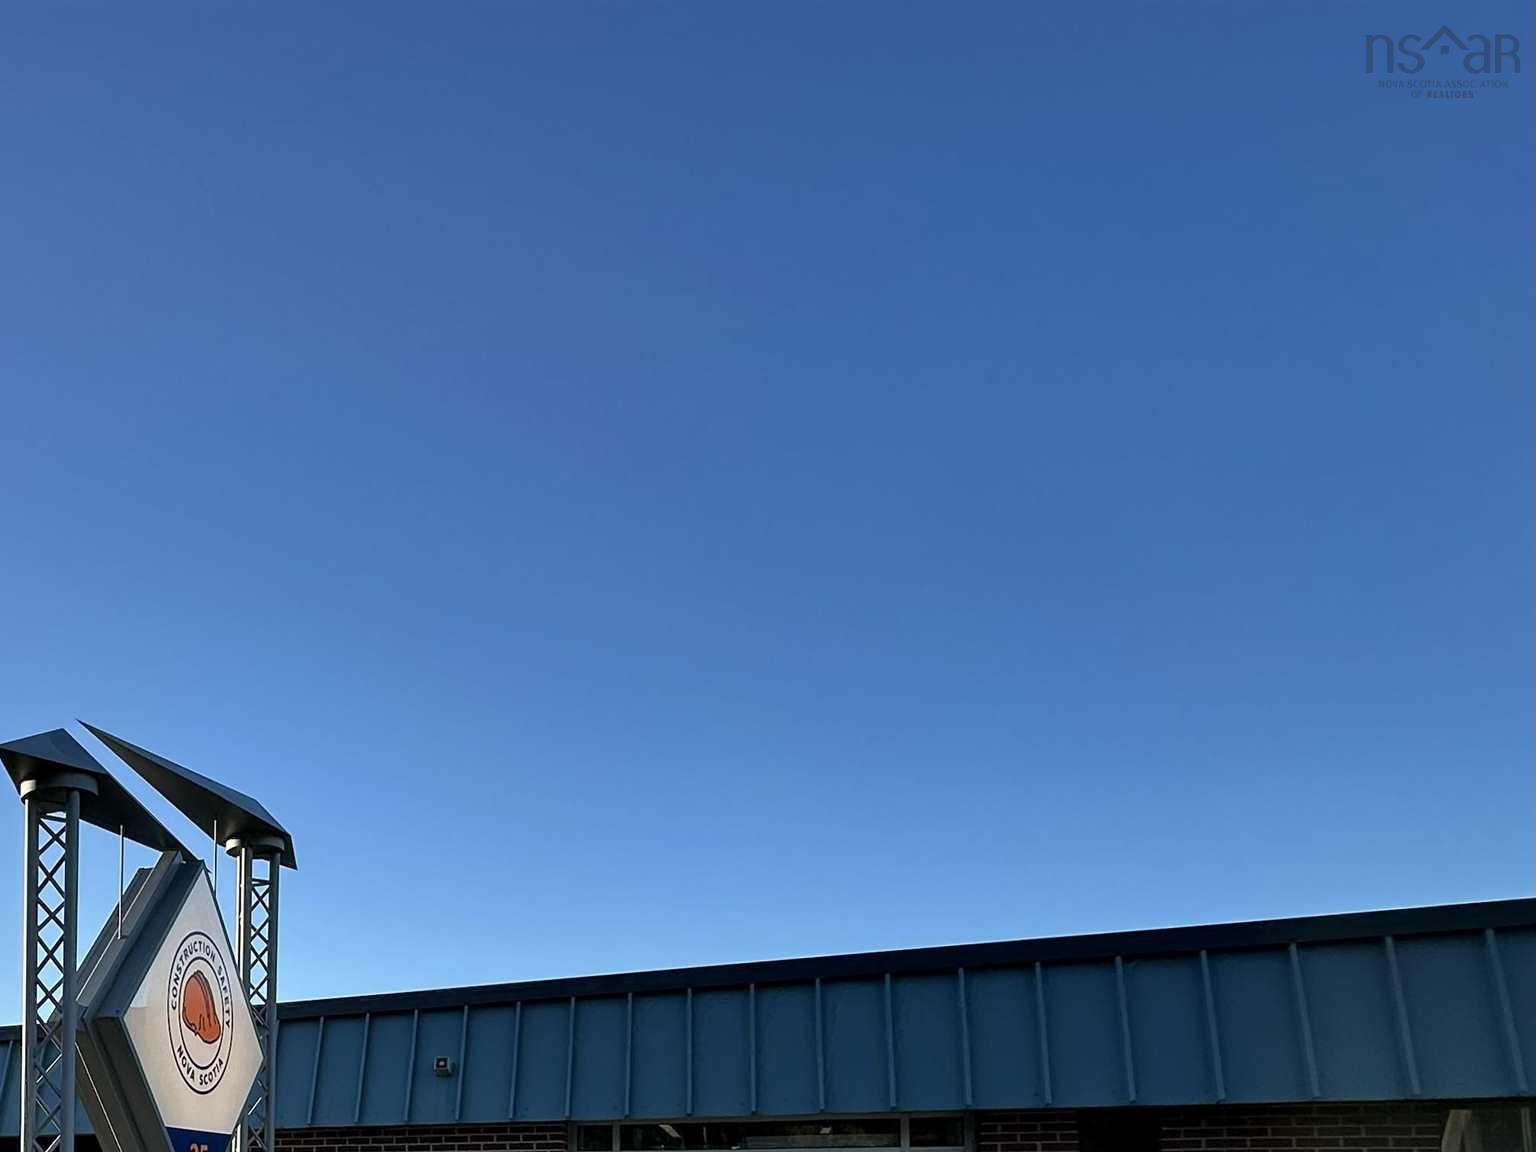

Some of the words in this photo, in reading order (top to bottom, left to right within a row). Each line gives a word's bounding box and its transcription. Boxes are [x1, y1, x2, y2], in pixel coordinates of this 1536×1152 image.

[171, 940, 216, 1010] CONSTRUCTION
[218, 965, 231, 1028] SAFETY
[177, 1045, 195, 1081] NOVA
[199, 1058, 224, 1085] SCOTIA
